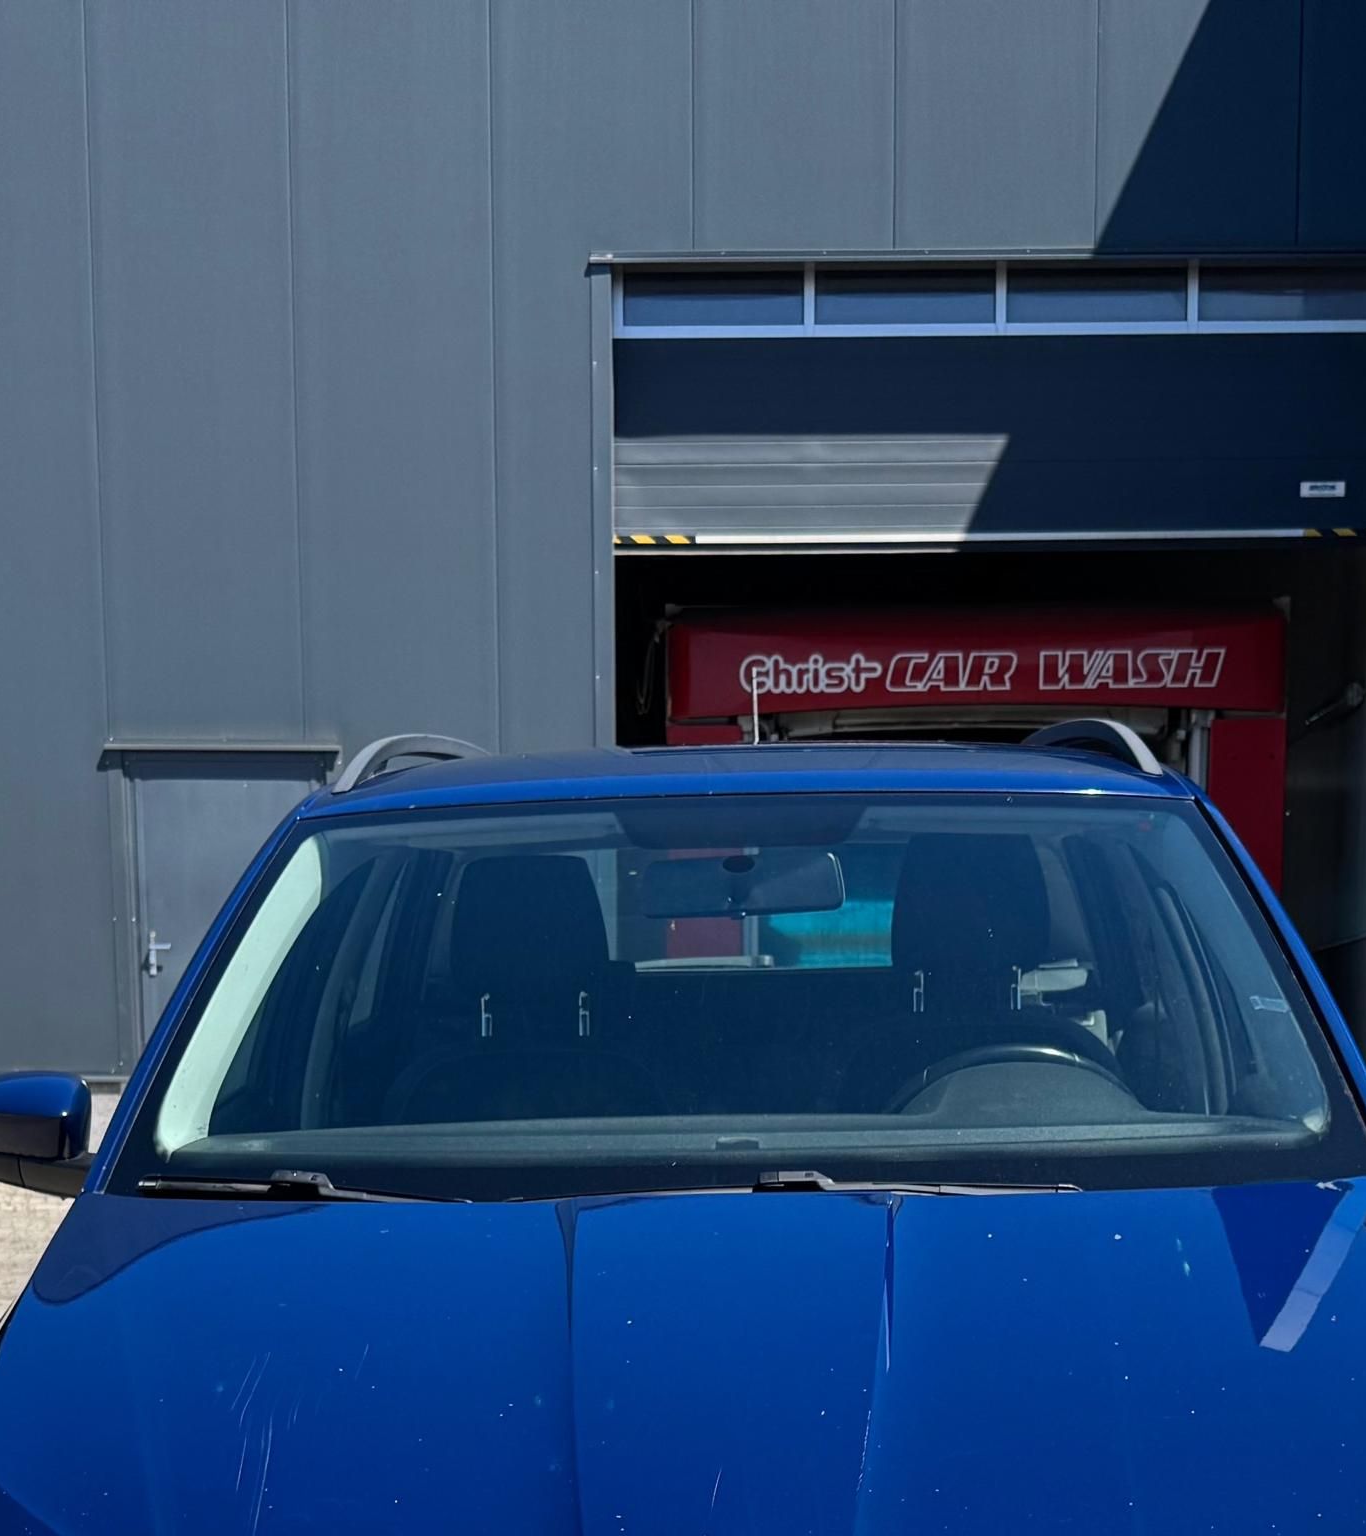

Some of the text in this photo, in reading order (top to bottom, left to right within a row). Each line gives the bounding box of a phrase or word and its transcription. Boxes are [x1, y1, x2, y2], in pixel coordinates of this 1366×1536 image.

[739, 647, 1226, 694] Christ CAR WASH
